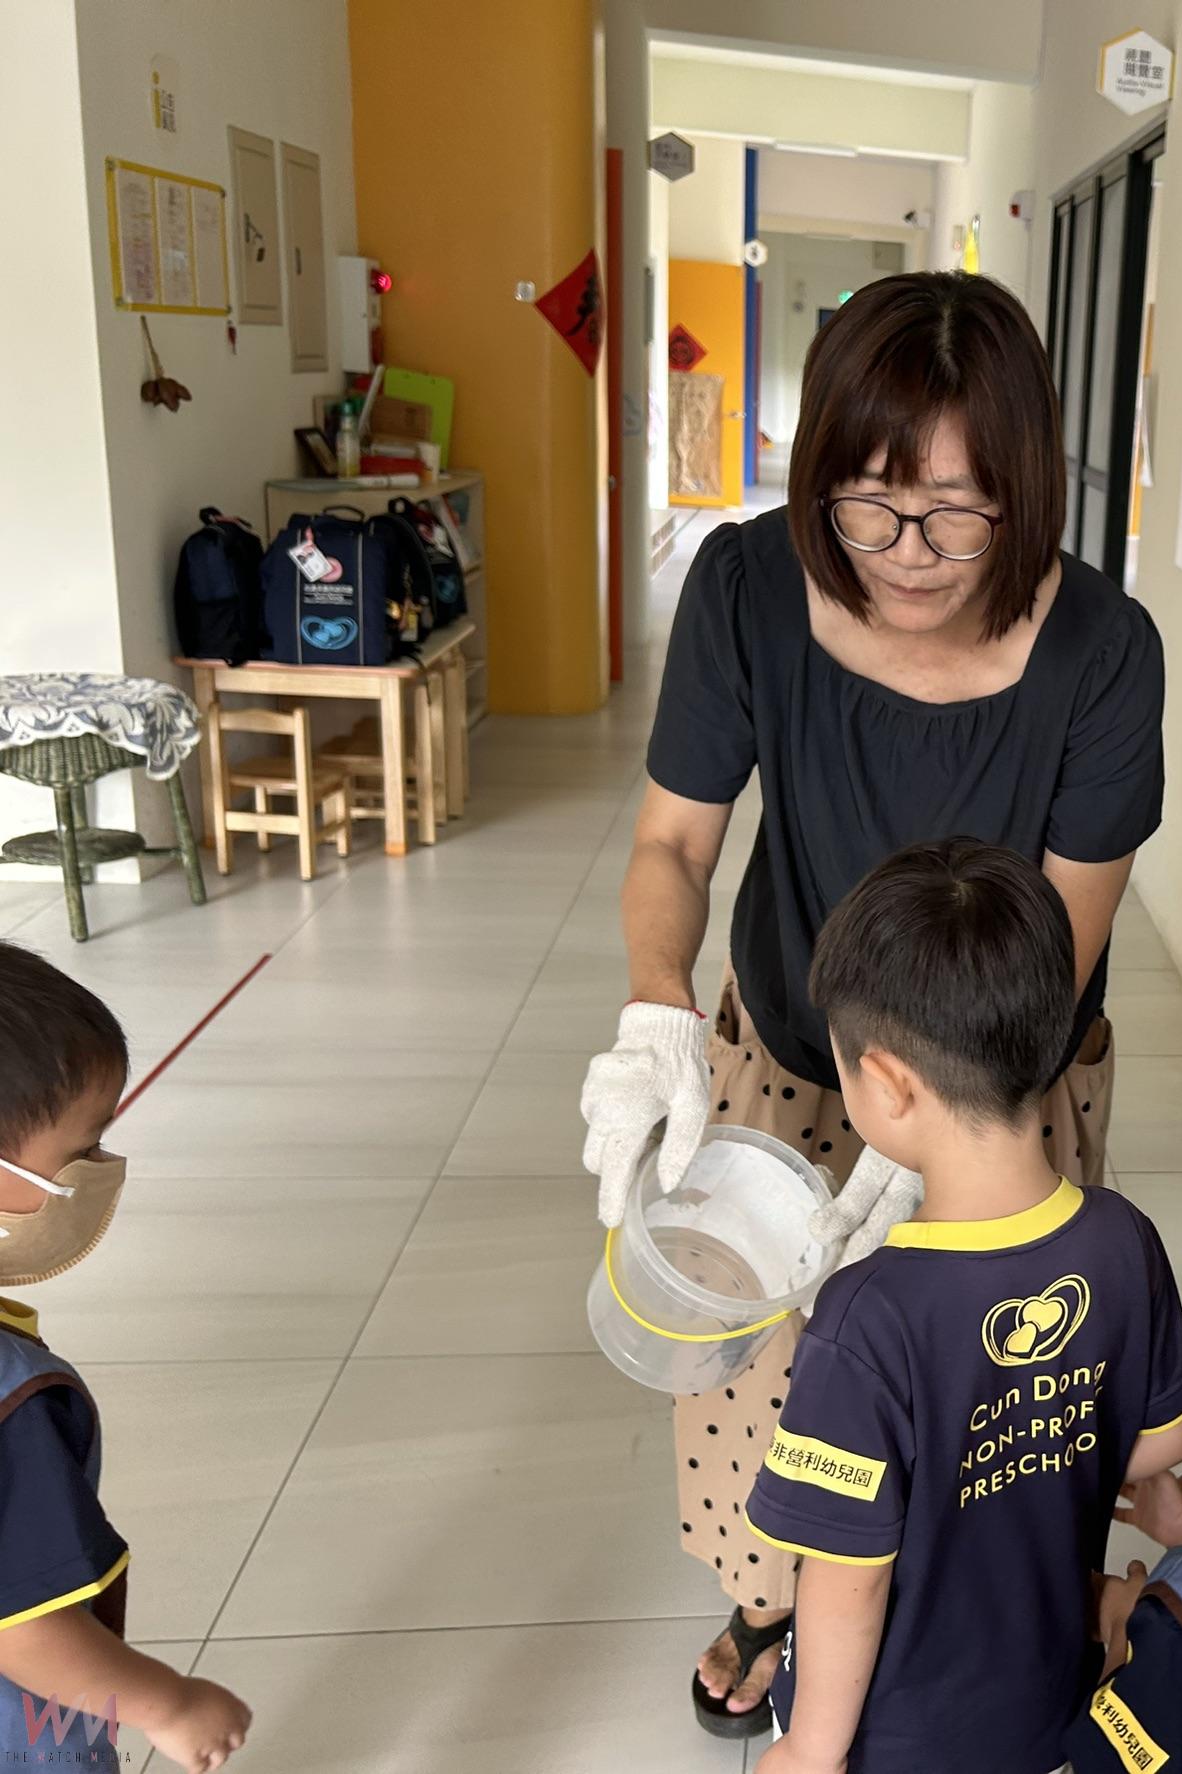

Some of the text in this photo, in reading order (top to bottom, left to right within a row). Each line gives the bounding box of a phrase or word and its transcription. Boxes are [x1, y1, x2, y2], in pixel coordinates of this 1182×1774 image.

[970, 1360, 1106, 1431] Cun Dong
[769, 1437, 873, 1488] 非營利幼兒園
[959, 1400, 1094, 1478] NON-PROF
[960, 1432, 1096, 1509] PRESCHOO
